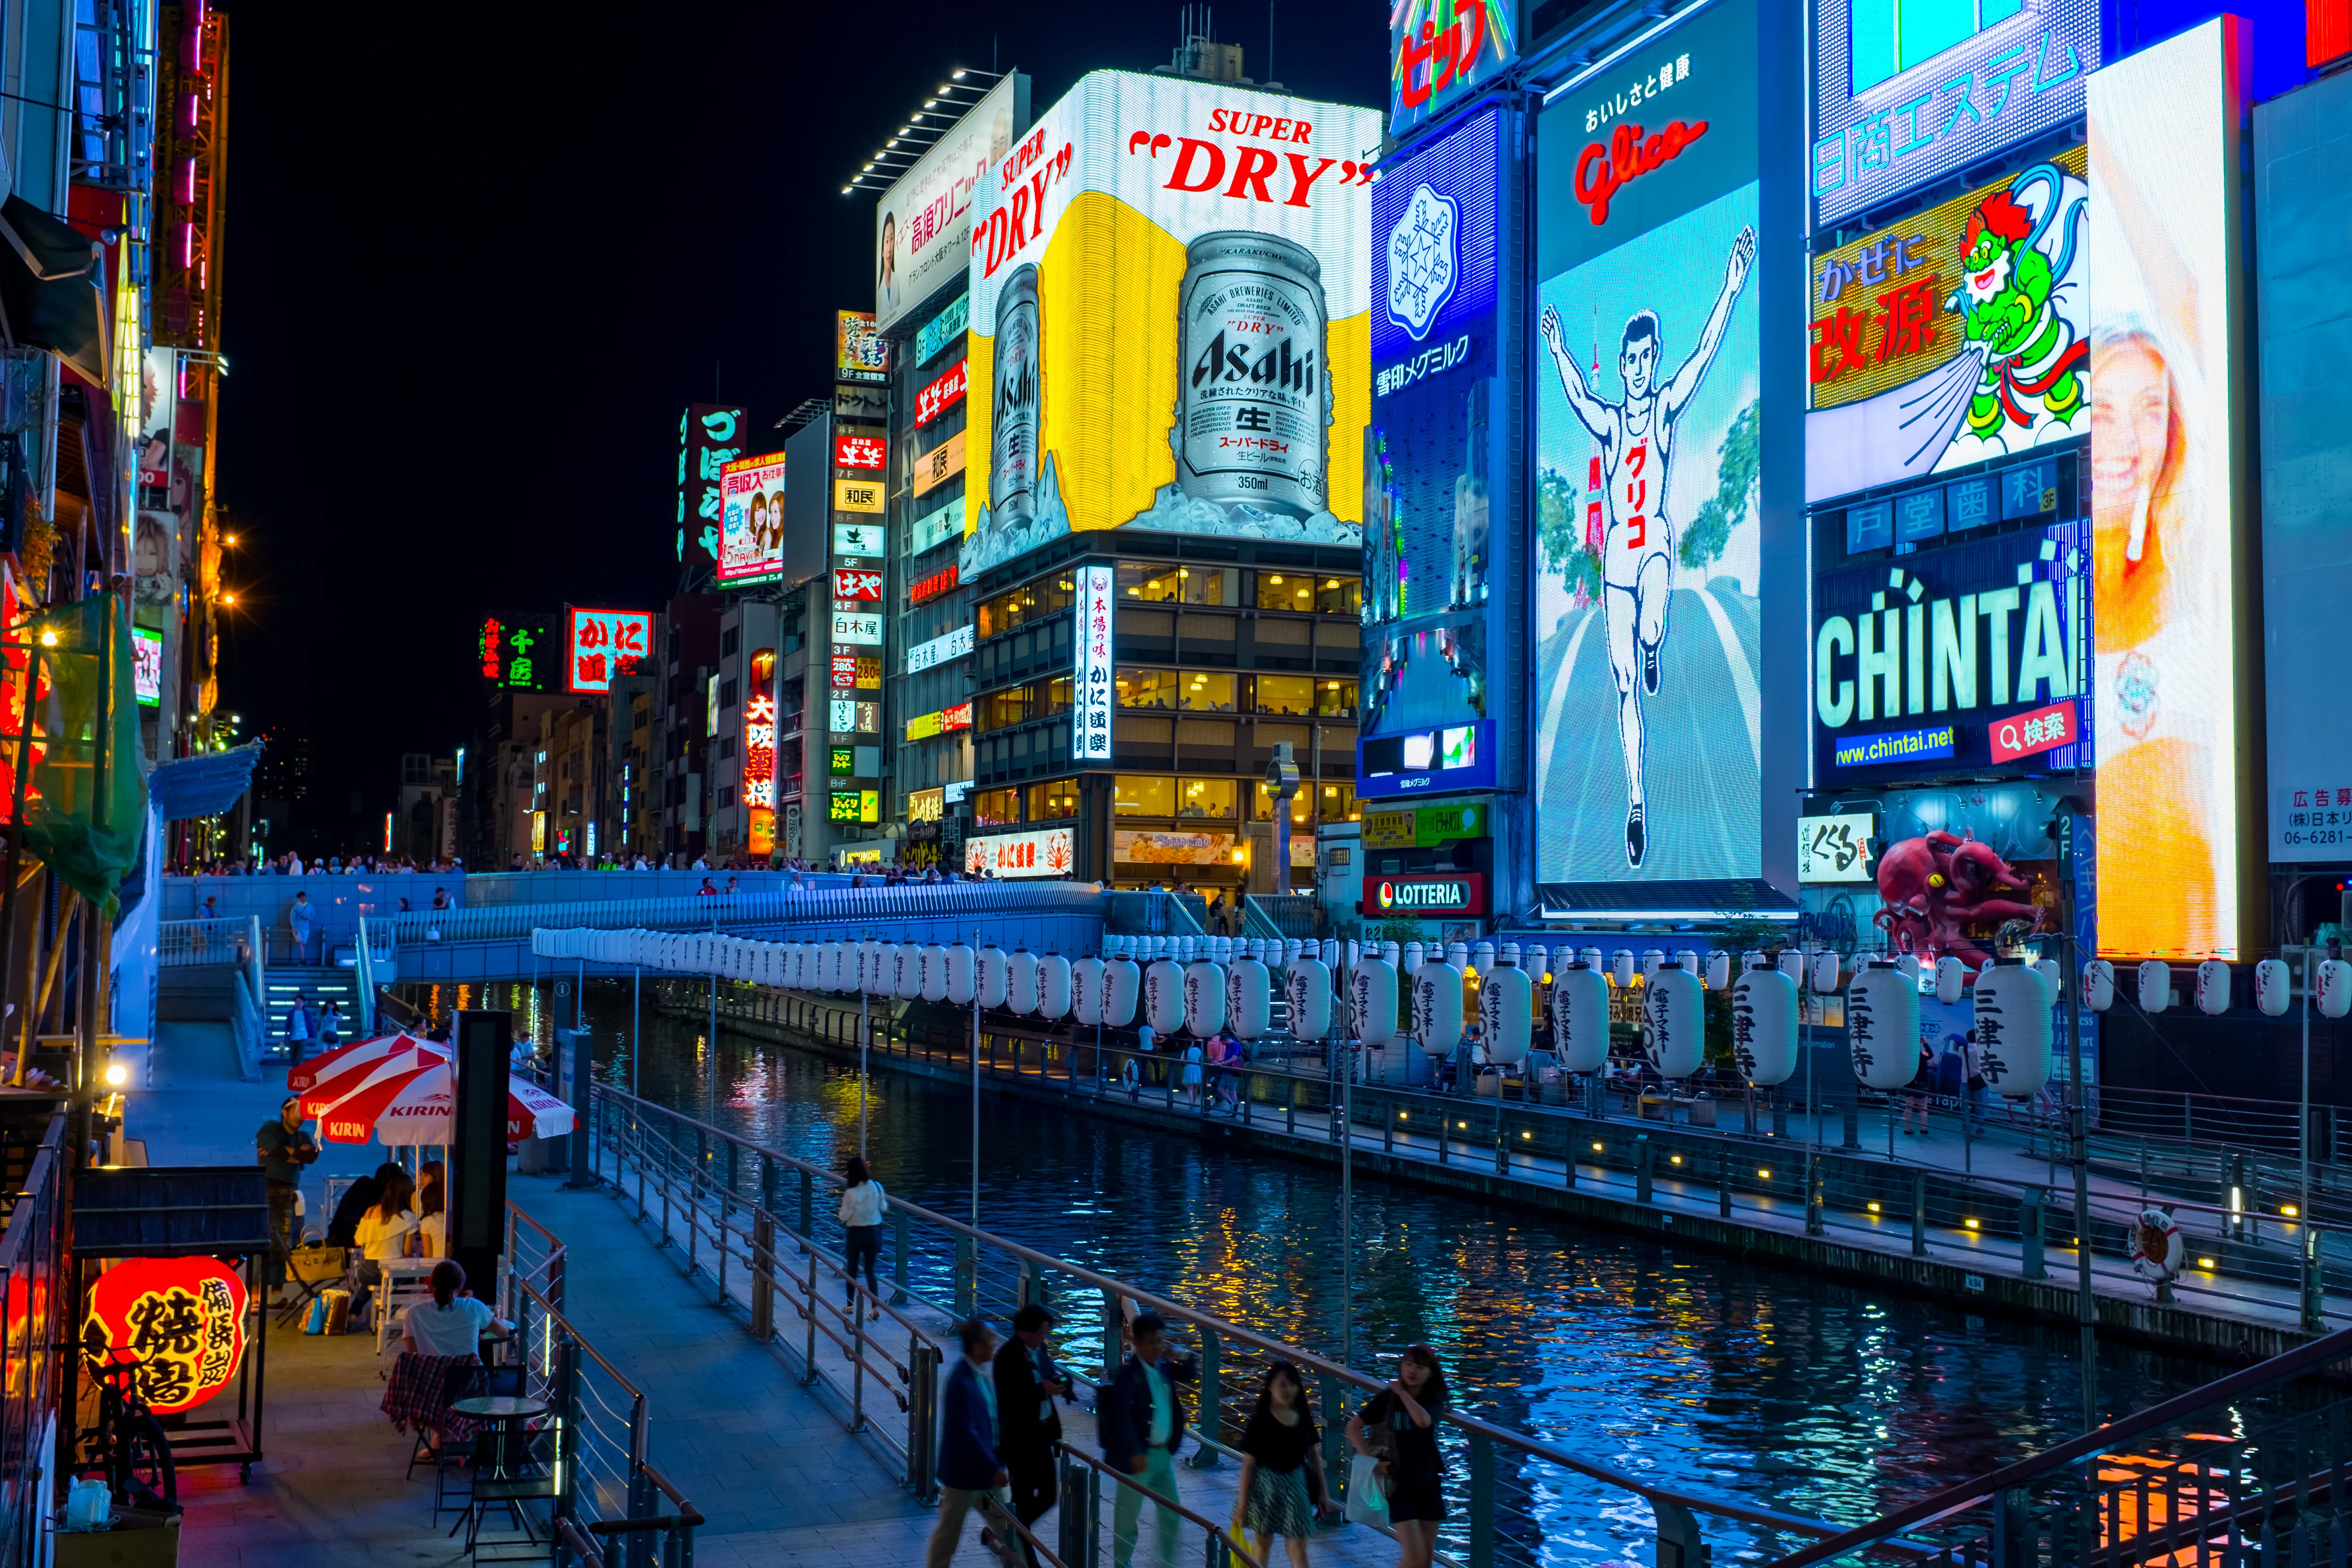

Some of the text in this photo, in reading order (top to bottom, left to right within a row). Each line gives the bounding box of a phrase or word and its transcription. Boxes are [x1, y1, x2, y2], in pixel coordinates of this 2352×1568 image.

[1586, 54, 1690, 132] おいしさと健康
[1209, 108, 1312, 144] SUPER
[1813, 31, 2080, 197] 日商エステム
[1002, 128, 1045, 191] SUPER
[1575, 121, 1706, 225] Glico
[1818, 235, 1923, 302] かぜに
[1208, 286, 1301, 326] ASAHI BREWERIES LIMITED
[1809, 275, 1935, 383] 改源
[918, 339, 925, 360] 9F
[1192, 328, 1313, 398] Asahi
[1376, 335, 1469, 397] 雪印メグミルク
[842, 369, 854, 379] 9F
[996, 355, 1035, 432] Asahi
[1200, 387, 1309, 411] 洗練されたクリアな味、辛口。
[1236, 407, 1271, 432] 生
[1219, 437, 1288, 453] スーパードライ
[1237, 451, 1269, 463] 生ビール
[933, 449, 947, 479] 和民
[727, 472, 764, 496] 高収入
[846, 490, 873, 503] 和民
[1238, 477, 1267, 490] 350ml
[1625, 437, 1648, 550] グリコ
[2042, 492, 2055, 508] 3F
[845, 558, 857, 567] 5F
[835, 573, 881, 597] はや
[578, 618, 643, 651] かに
[835, 617, 878, 635] 白木屋
[951, 630, 973, 656] 白木屋
[1092, 597, 1106, 658] 本場の味
[510, 629, 534, 680] 千房
[833, 662, 855, 672] 280円
[915, 645, 936, 670] 白木屋
[1816, 572, 2086, 727] CHINTAI
[858, 665, 880, 679] 280円
[1090, 665, 1107, 751] かに道楽
[2024, 713, 2065, 747] 検索
[743, 694, 773, 807] 大阪王将
[831, 779, 846, 787] B1F
[1400, 777, 1430, 789] 雪印メグミルク
[831, 808, 859, 819] ドンキー
[833, 797, 858, 808] びっくり
[997, 841, 1035, 869] かに道楽
[1812, 824, 1857, 871] くくる
[2061, 815, 2070, 860] 2F
[1396, 884, 1460, 904] LOTTERIA
[1039, 967, 1047, 1006] 電子マネー
[1074, 972, 1083, 1012] 電子マネー
[1105, 974, 1114, 1014] 電子マネー
[1149, 976, 1159, 1019] 電子マネー
[1188, 978, 1199, 1022] 電子マネー
[1231, 975, 1242, 1022] 電子マネー
[1296, 976, 1308, 1023] 電子マネー
[1357, 975, 1370, 1028] 電子マネー
[1421, 981, 1435, 1037] 電子マネー
[1488, 982, 1502, 1041] 電子マネー
[1557, 991, 1571, 1051] 電子マネー
[1653, 989, 1670, 1053] 電子マネー
[2057, 1010, 2093, 1026] Exess
[1733, 984, 1756, 1078] 三津寺
[1802, 1040, 1835, 1049] inormation
[1849, 987, 1875, 1078] 三津寺
[1974, 989, 2009, 1084] 三津寺
[2057, 1031, 2094, 1046] Aiort
[389, 1106, 452, 1117] KIRIN
[528, 1098, 562, 1112] KIRIN
[330, 1122, 365, 1138] KIRIN
